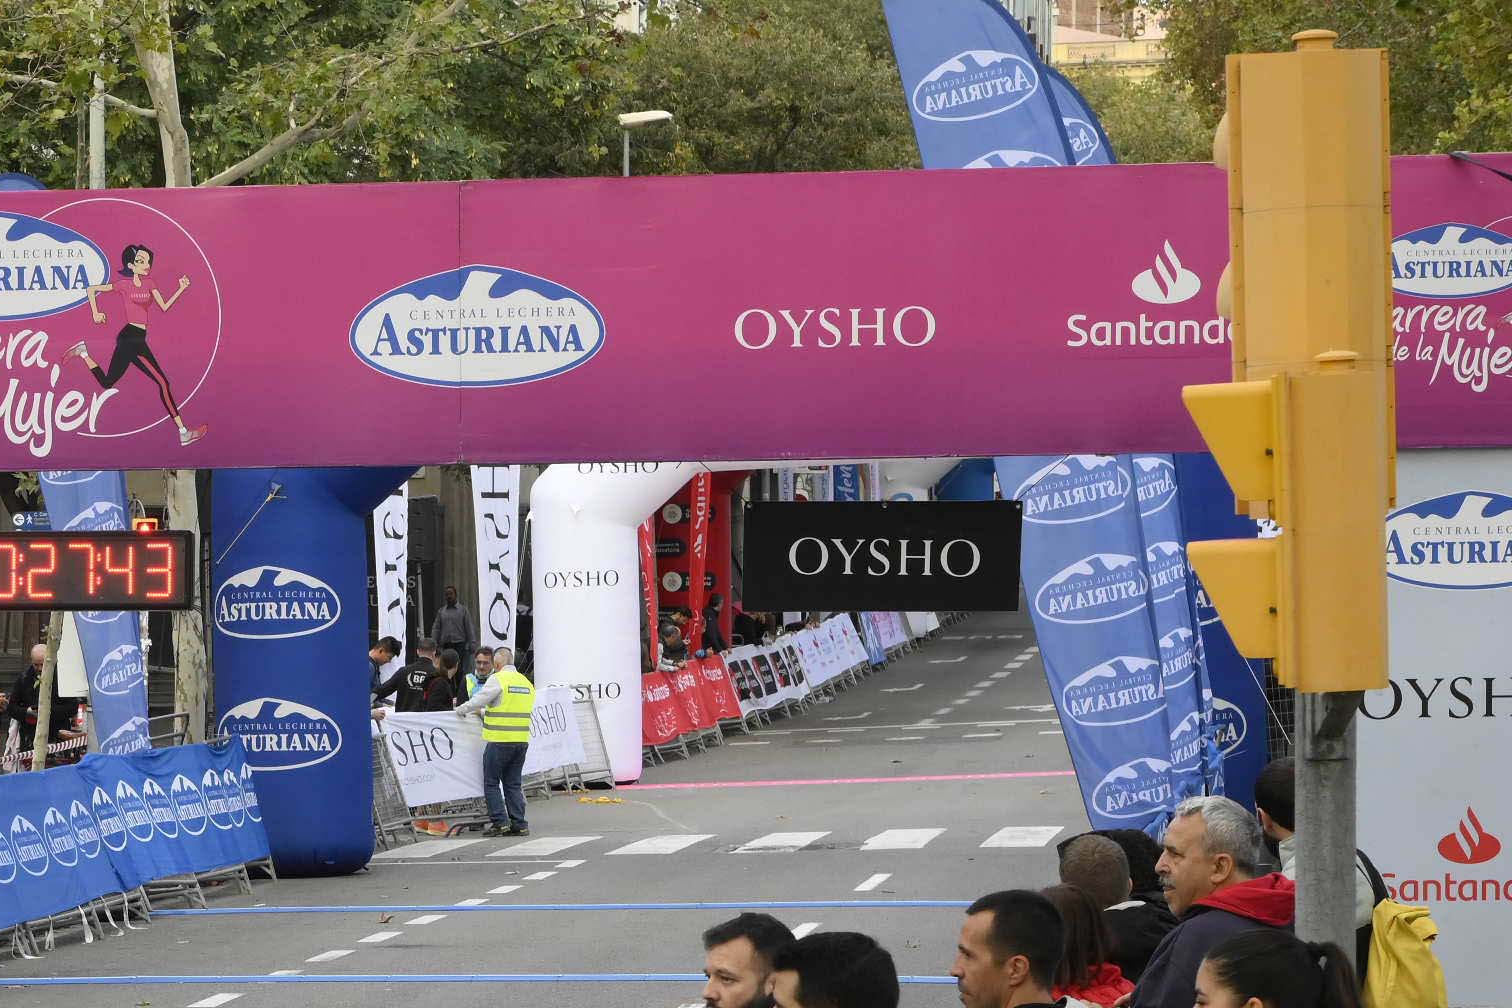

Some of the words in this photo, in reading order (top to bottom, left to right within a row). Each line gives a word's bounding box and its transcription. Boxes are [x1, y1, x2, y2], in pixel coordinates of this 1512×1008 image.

[13, 248, 84, 259] LECHERA
[1464, 248, 1512, 257] LECHER
[409, 308, 487, 319] CENTRAL
[497, 306, 577, 318] LECHERA
[1392, 303, 1487, 333] arrera
[369, 312, 585, 357] ASTURIANA
[734, 305, 937, 350] OYSHO
[1415, 334, 1433, 361] la
[1429, 326, 1512, 393] Muje
[1413, 525, 1482, 535] CENTRAL
[788, 536, 981, 578] OYSHO
[544, 569, 620, 589] OYSHO
[231, 590, 273, 600] CENTRAL
[278, 590, 327, 600] LECHERA
[219, 598, 332, 624] ASTURIANA
[233, 722, 274, 732] CENTRAL
[278, 722, 328, 731] LECHERA
[390, 726, 454, 768] SHO
